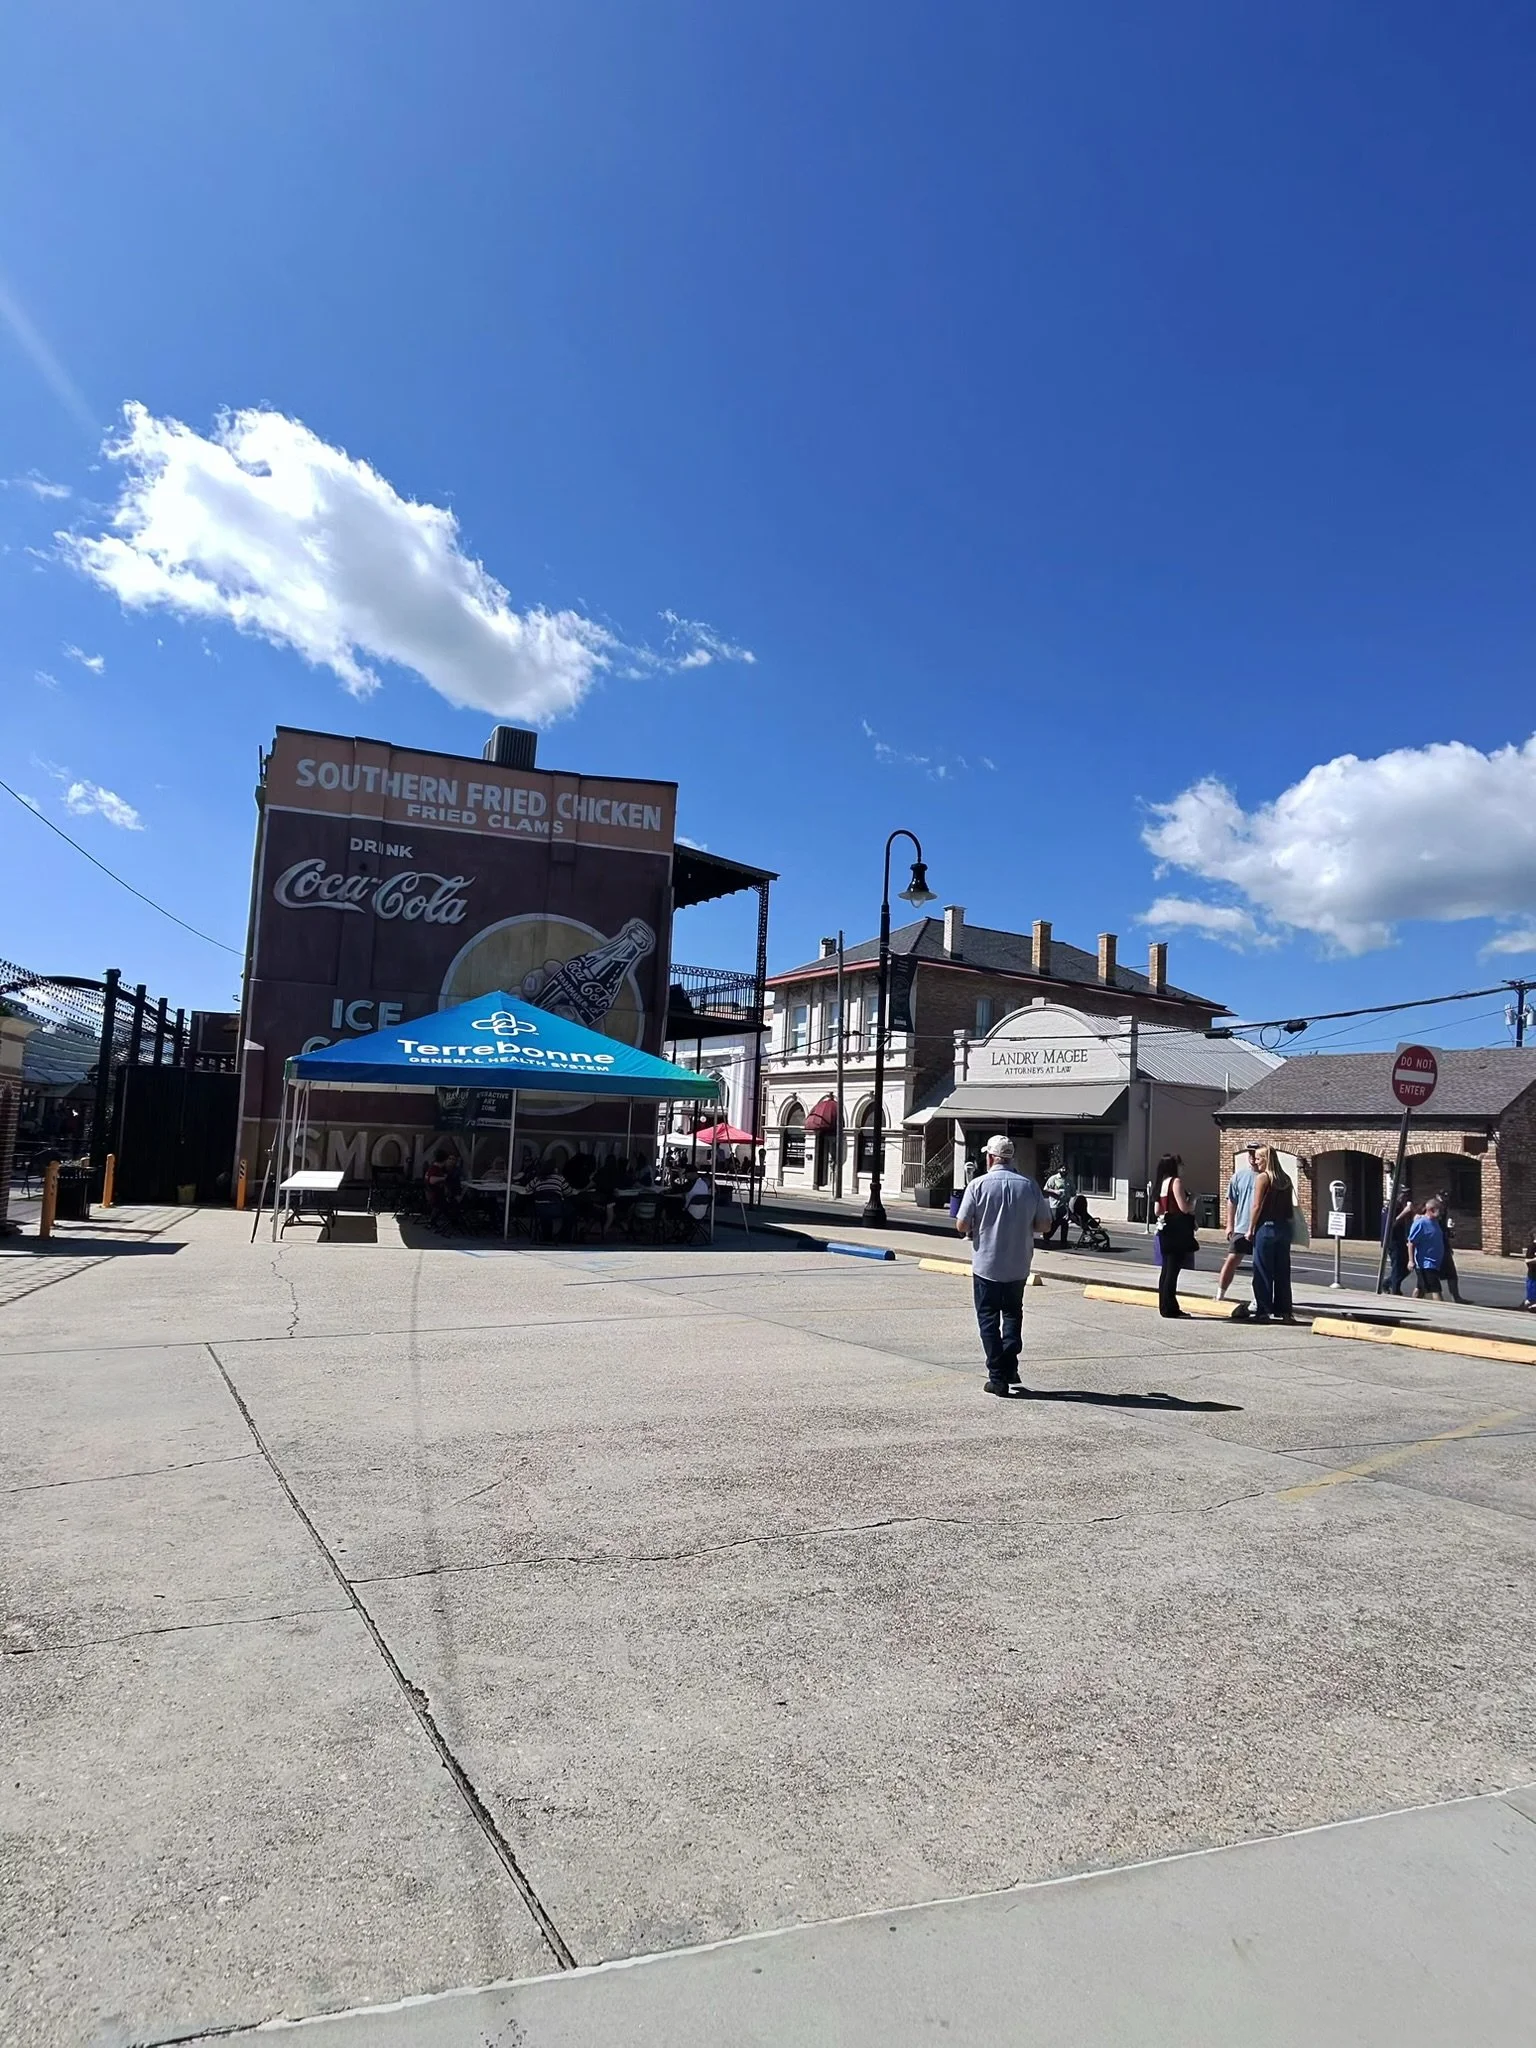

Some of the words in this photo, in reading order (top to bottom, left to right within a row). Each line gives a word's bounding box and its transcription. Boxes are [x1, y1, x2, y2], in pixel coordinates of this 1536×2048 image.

[296, 758, 458, 806] SOUTHERN
[467, 782, 547, 817] FRIED
[557, 792, 662, 832] CHICKEN
[407, 804, 477, 825] FRIED
[487, 814, 564, 834] CLAMS
[350, 838, 414, 859] DRINK
[331, 998, 403, 1033] ICE
[397, 1039, 615, 1065] Terrebonne
[991, 1051, 1039, 1066] LANDRY
[1043, 1048, 1088, 1064] MAGEE
[1401, 1056, 1412, 1066] DO
[1416, 1059, 1432, 1069] NOT
[408, 1056, 484, 1065] GENERAL
[488, 1056, 547, 1067] HEALTH
[551, 1062, 610, 1073] SYSTEM
[1004, 1066, 1044, 1075] ATTORNEYS
[1045, 1066, 1055, 1074] AT
[1056, 1065, 1072, 1074] LAW
[1400, 1084, 1425, 1096] ENTER
[287, 1129, 488, 1180] SMOKY
